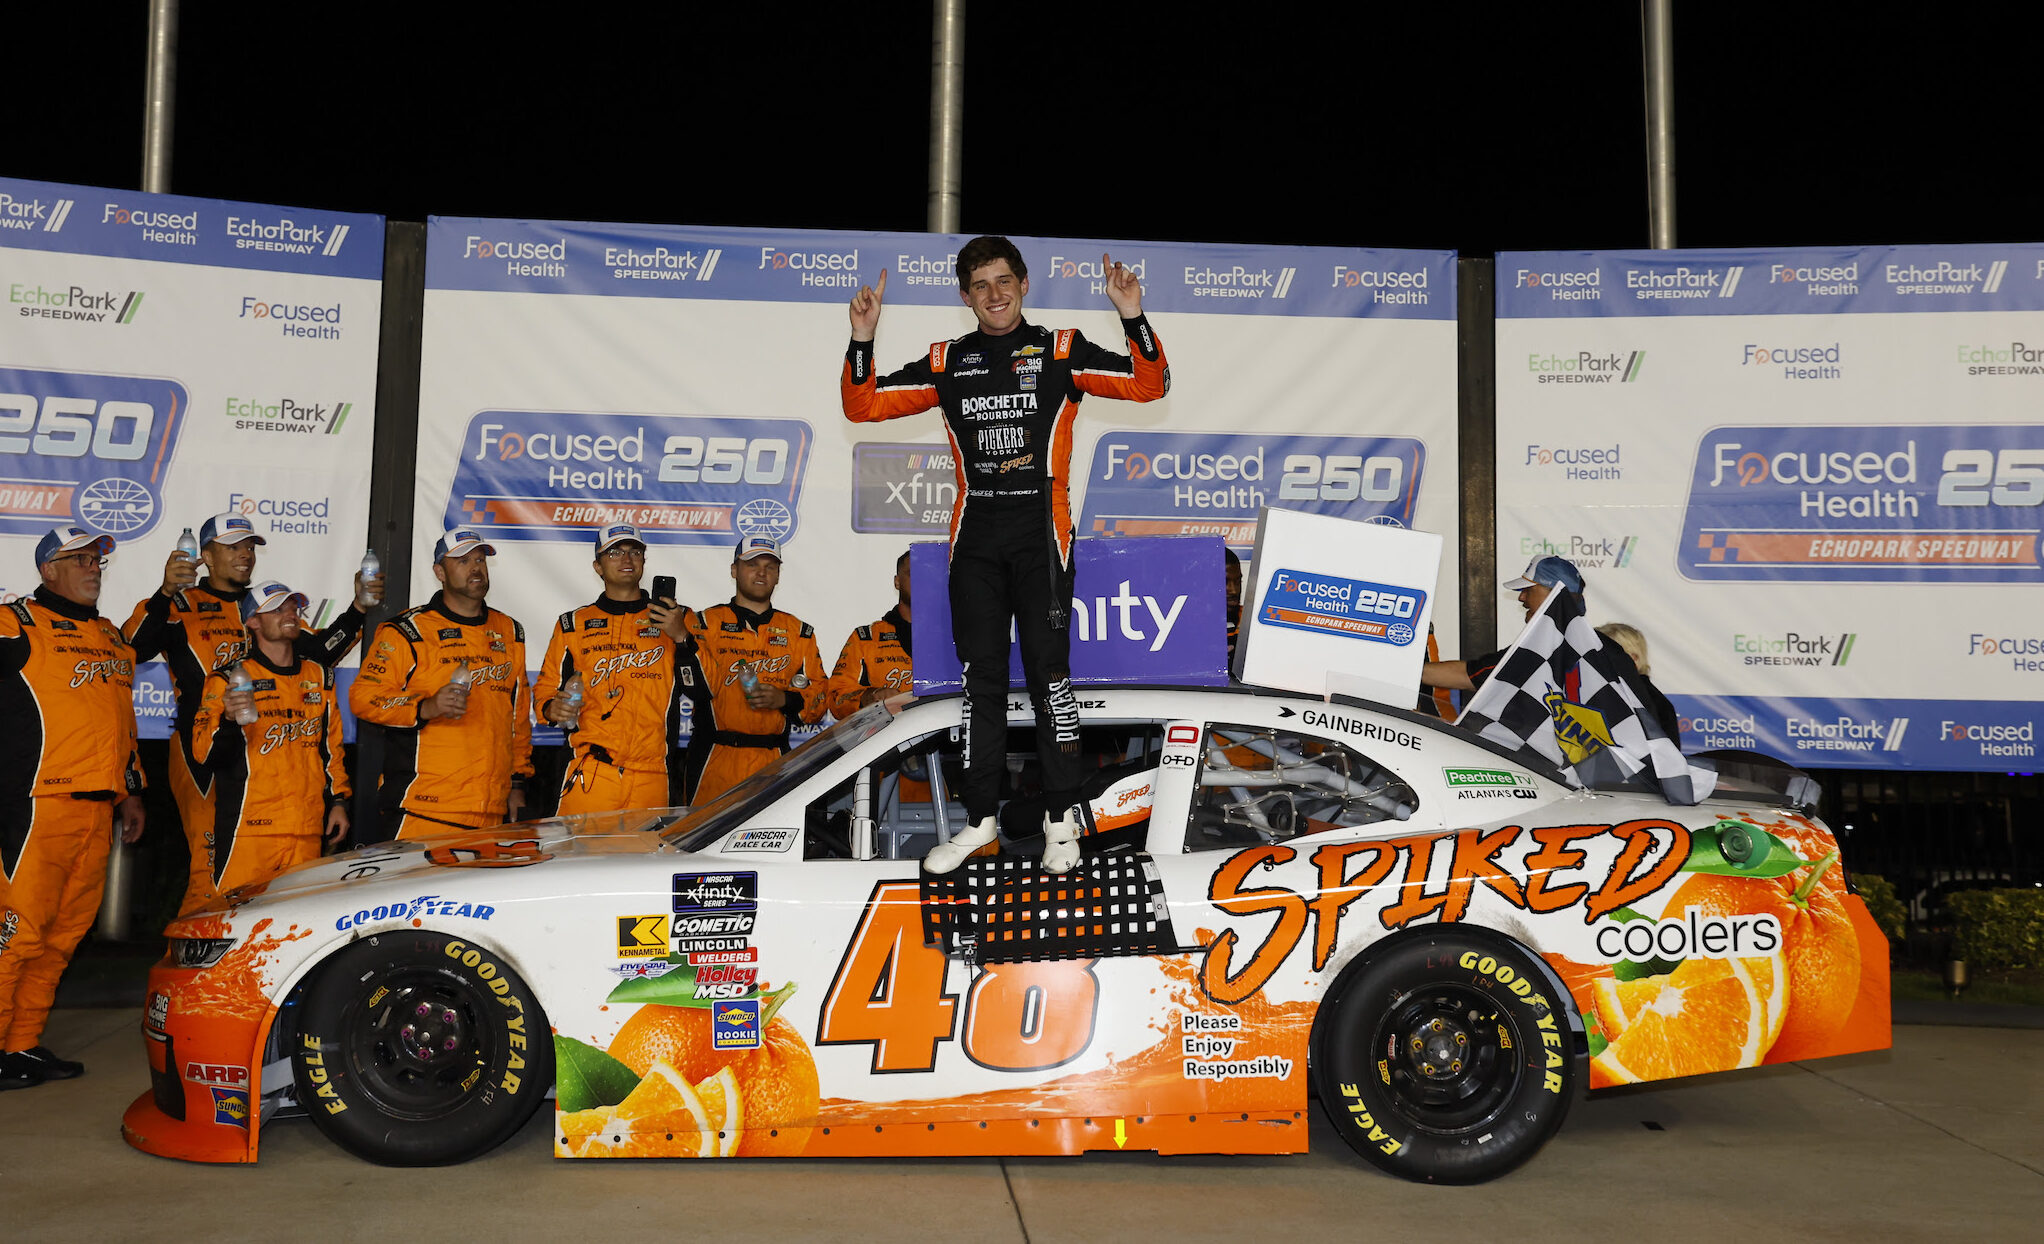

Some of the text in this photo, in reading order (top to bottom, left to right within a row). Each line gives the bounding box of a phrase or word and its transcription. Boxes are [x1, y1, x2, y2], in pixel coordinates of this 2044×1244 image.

[0, 193, 46, 219] Park
[102, 204, 197, 230] Focused
[143, 229, 196, 245] Health
[227, 217, 324, 243] EchoPark
[235, 239, 314, 254] SPEEDWAY
[464, 236, 565, 261] Focused
[605, 248, 698, 270] EchoPark
[759, 247, 858, 272] Focused
[898, 254, 958, 274] EchoP
[1048, 256, 1145, 279] Focud
[507, 262, 566, 278] Health
[614, 269, 689, 281] SPEEDWAY
[801, 272, 859, 289] Health
[907, 275, 960, 286] SPEEDW
[1184, 266, 1275, 287] EchoPark
[1332, 265, 1427, 289] Focused
[1515, 268, 1600, 289] Focused
[1626, 266, 1719, 289] EchoPark
[1769, 262, 1858, 284] Focused
[1885, 261, 1982, 285] EchoPark
[10, 284, 117, 311] EchoPark
[1193, 287, 1265, 299] SPEEDWAY
[1373, 290, 1428, 305] Health
[1551, 286, 1600, 300] Health
[1636, 289, 1712, 299] SPEEDWAY
[1807, 281, 1859, 296] Health
[1896, 285, 1974, 294] SPEEDWAY
[20, 307, 106, 322] SPEEDWAY
[239, 297, 341, 323] Focused
[283, 324, 340, 340] Health
[1027, 358, 1042, 366] BIG
[1528, 351, 1621, 373] EchoPark
[1742, 343, 1840, 366] Focused
[1957, 342, 2044, 364] EchoPar
[1538, 373, 1612, 384] SPEEDWAY
[1784, 364, 1841, 380] Health
[226, 398, 326, 423] EchoPark
[962, 393, 1038, 415] BORCHETTA
[976, 409, 1023, 421] BOURBON
[235, 420, 316, 434] SPEEDWAY
[475, 424, 644, 462] Focused
[978, 427, 1025, 451] PICKERS
[658, 436, 789, 485] 250
[1104, 444, 1264, 481] Focused
[1525, 444, 1620, 465] Focused
[1710, 441, 1917, 488] Focused
[548, 466, 643, 490] Health
[1279, 454, 1404, 502] 250
[1566, 465, 1620, 480] Health
[1937, 449, 2044, 507] 25
[0, 489, 60, 510] DWAY
[229, 494, 328, 518] Focused
[1174, 484, 1265, 509] Health
[1800, 490, 1918, 518] Health
[270, 519, 328, 535] Health
[552, 506, 723, 527] ECHOPARK SPEEDWAY
[1520, 535, 1613, 556] EchoPark
[1808, 539, 2023, 559] ECHOPARK SPEEDWAY
[1274, 574, 1352, 601] Focused
[1305, 597, 1349, 613] Health
[1354, 590, 1416, 618] 250
[1305, 615, 1383, 634] ECHOPARK SPEEDWAY
[1733, 632, 1831, 655] EchoPark
[590, 645, 664, 688] SPIKED
[725, 654, 791, 687] SIKED
[1744, 656, 1822, 667] SPEEDWAY
[469, 662, 513, 690] PIKED
[630, 671, 662, 680] coolers
[1303, 710, 1422, 751] GAINBRIDGE
[1678, 714, 1755, 734] ocused
[1787, 717, 1884, 739] EchoPark
[1940, 721, 2033, 742] Focused
[1704, 735, 1756, 748] Health
[1796, 740, 1875, 751] SPEEDWAY
[1980, 743, 2035, 756] Health
[1449, 772, 1531, 785] Peachtree TV
[1458, 789, 1511, 799] ATLANTA'S
[733, 841, 781, 849] RACE CAR
[746, 831, 787, 840] NASCAR
[704, 875, 733, 883] NASCAR
[687, 884, 743, 903] xfinity
[335, 896, 495, 932] GOODYEAR
[1199, 818, 1693, 1004] SPIKED
[674, 916, 753, 934] COMETIC
[1597, 911, 1777, 957] coolers
[682, 939, 744, 952] LINCOLN
[697, 952, 752, 963] WELDERS
[695, 964, 757, 985] Holley
[815, 879, 1101, 1074] 48
[693, 984, 750, 999] MSD
[156, 994, 169, 1012] BIG
[445, 941, 527, 1095] GOODYEAR
[719, 1013, 754, 1021] SUNOCO
[1185, 1015, 1239, 1029] Please
[1459, 951, 1564, 1094] GOODYEAR
[717, 1031, 757, 1039] ROOKIE
[1185, 1038, 1232, 1056] Enjoy
[186, 1064, 247, 1082] ARP
[304, 1033, 348, 1116] EAGLE
[1186, 1060, 1289, 1079] Responsibly
[1340, 1083, 1402, 1157] EAGLE
